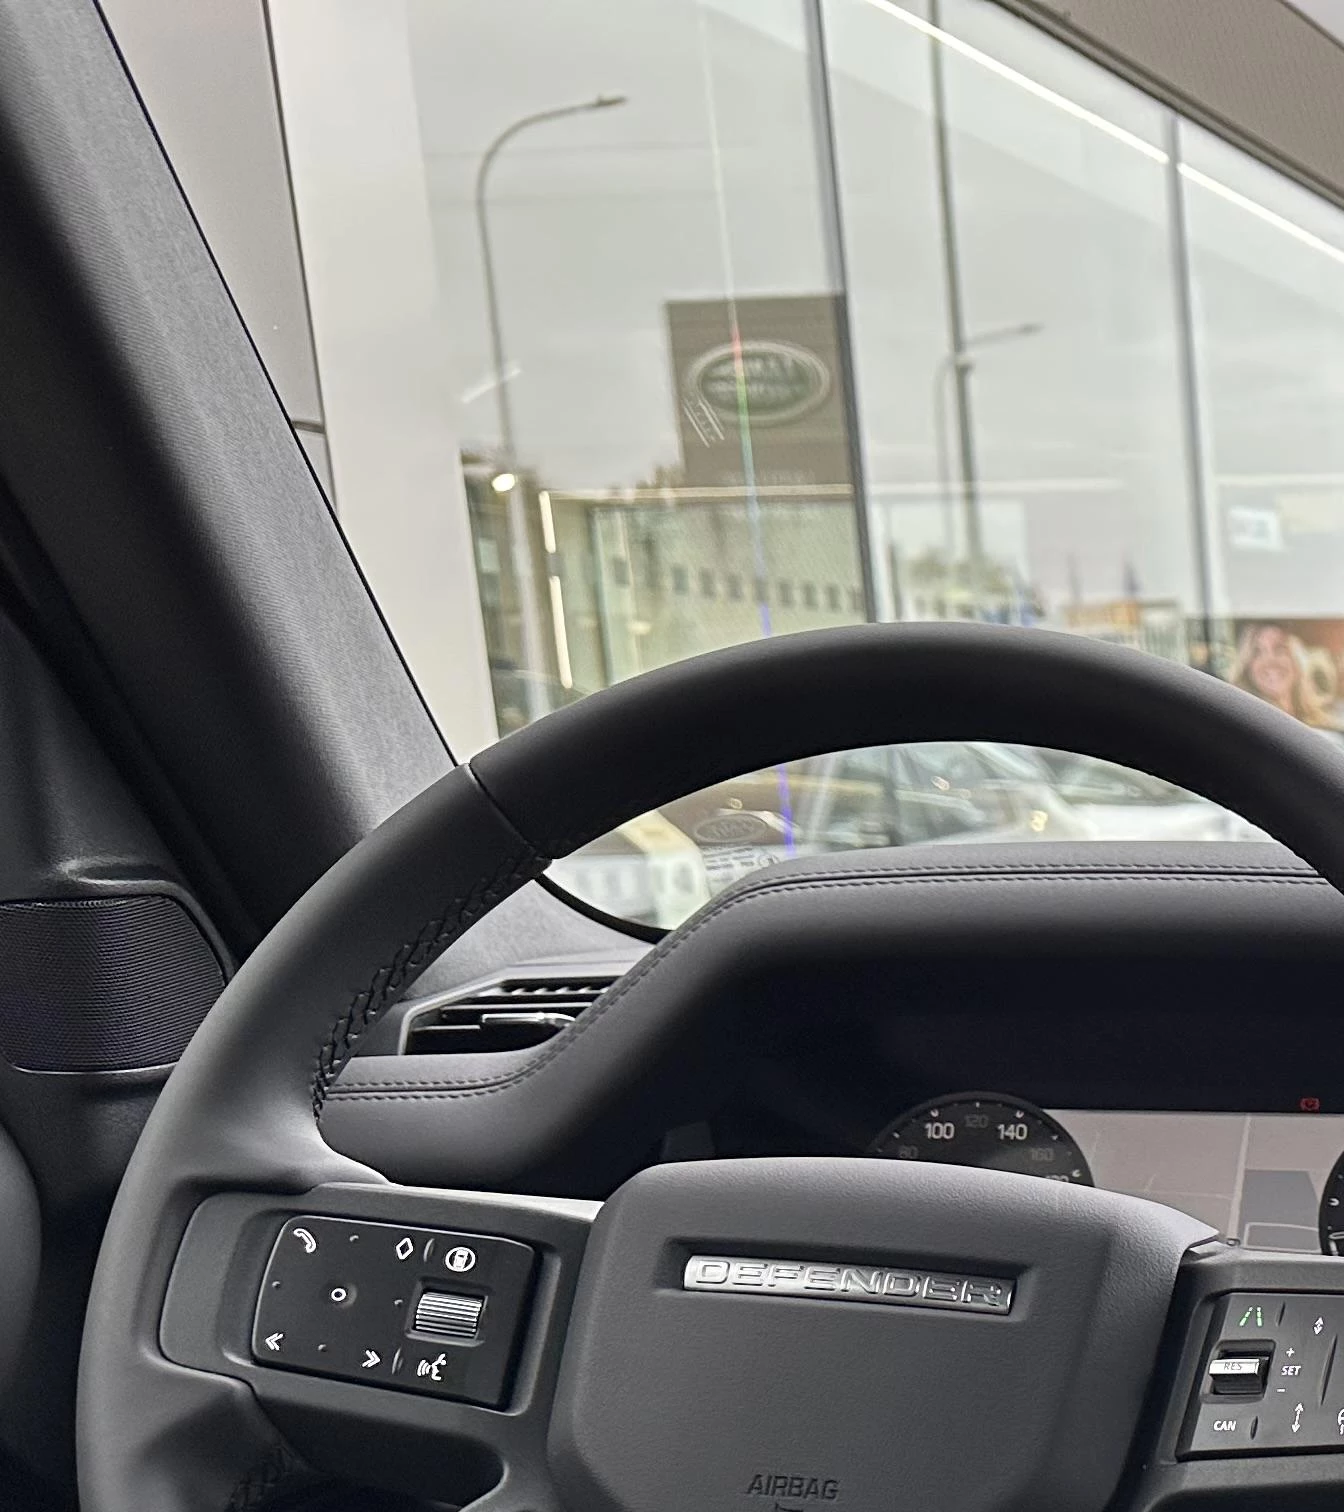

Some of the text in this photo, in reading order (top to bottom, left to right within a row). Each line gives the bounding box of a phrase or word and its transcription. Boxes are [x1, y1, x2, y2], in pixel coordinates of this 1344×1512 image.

[924, 1122, 955, 1140] 100
[998, 1123, 1028, 1140] 140
[695, 1258, 1004, 1307] DEFENDER
[1223, 1362, 1243, 1371] RES
[1281, 1365, 1302, 1376] SET
[1213, 1420, 1237, 1432] CAN
[746, 1473, 840, 1500] AIRBAG
